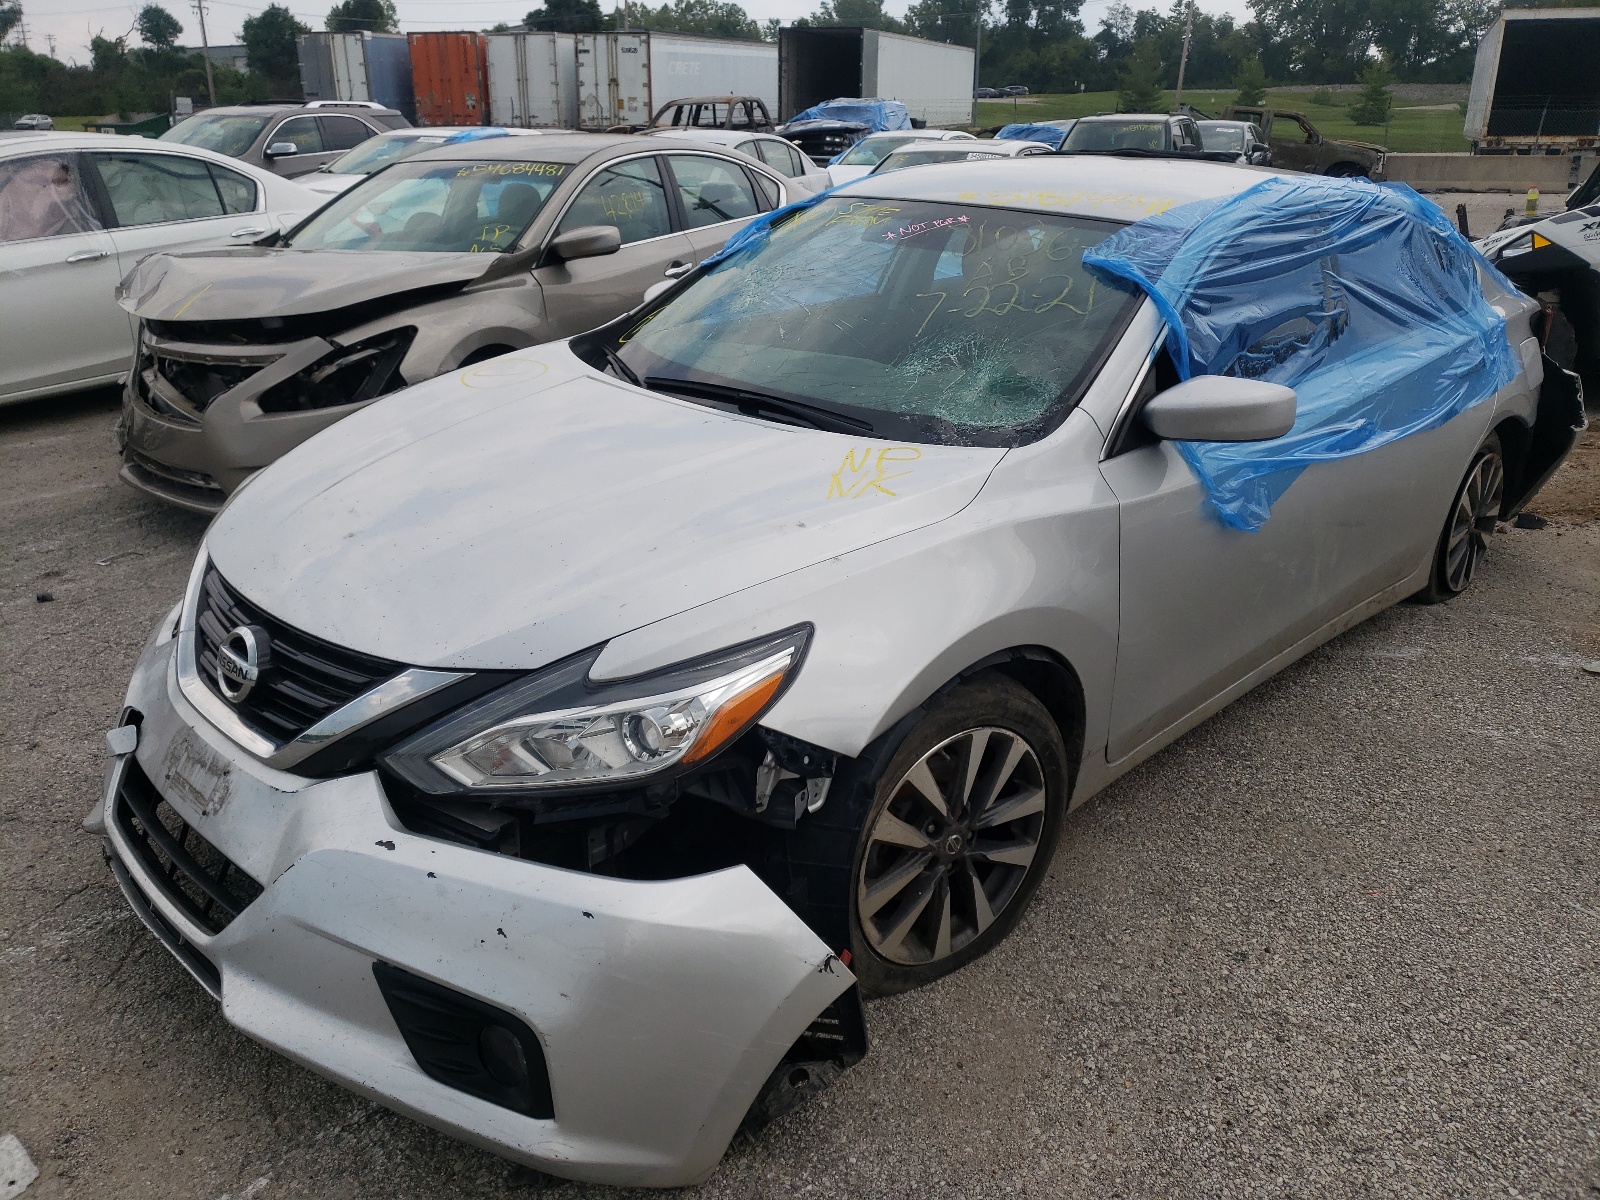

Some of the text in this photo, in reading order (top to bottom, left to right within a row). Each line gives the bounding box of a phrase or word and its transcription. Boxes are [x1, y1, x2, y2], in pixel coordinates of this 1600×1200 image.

[899, 221, 929, 236] NOT
[915, 274, 1099, 338] 7-22-21
[217, 653, 249, 681] ISSAN
